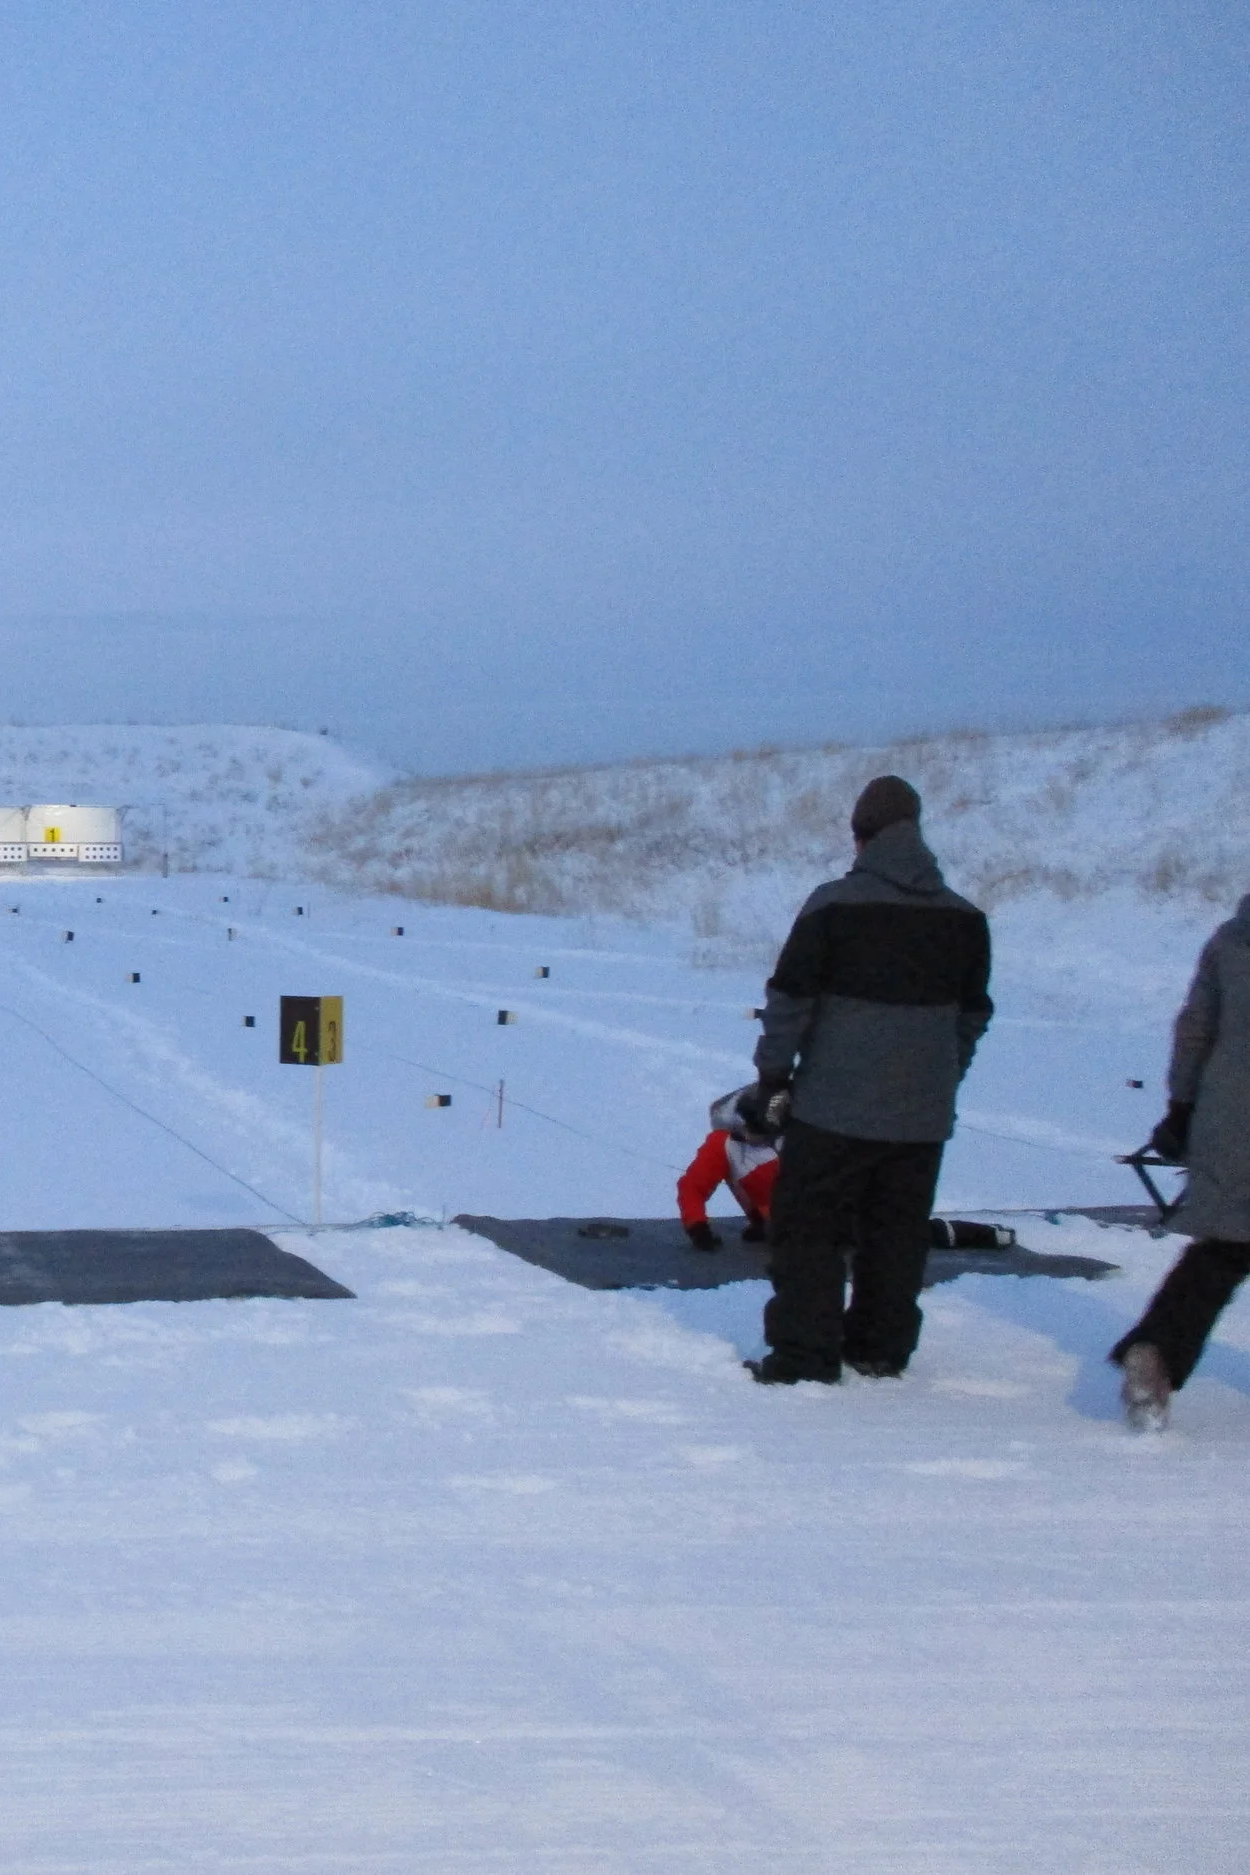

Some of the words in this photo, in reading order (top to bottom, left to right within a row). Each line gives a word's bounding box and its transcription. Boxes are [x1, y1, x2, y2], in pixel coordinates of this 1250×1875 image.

[49, 828, 55, 843] 1
[292, 1020, 308, 1064] 4
[328, 1020, 337, 1063] 3
